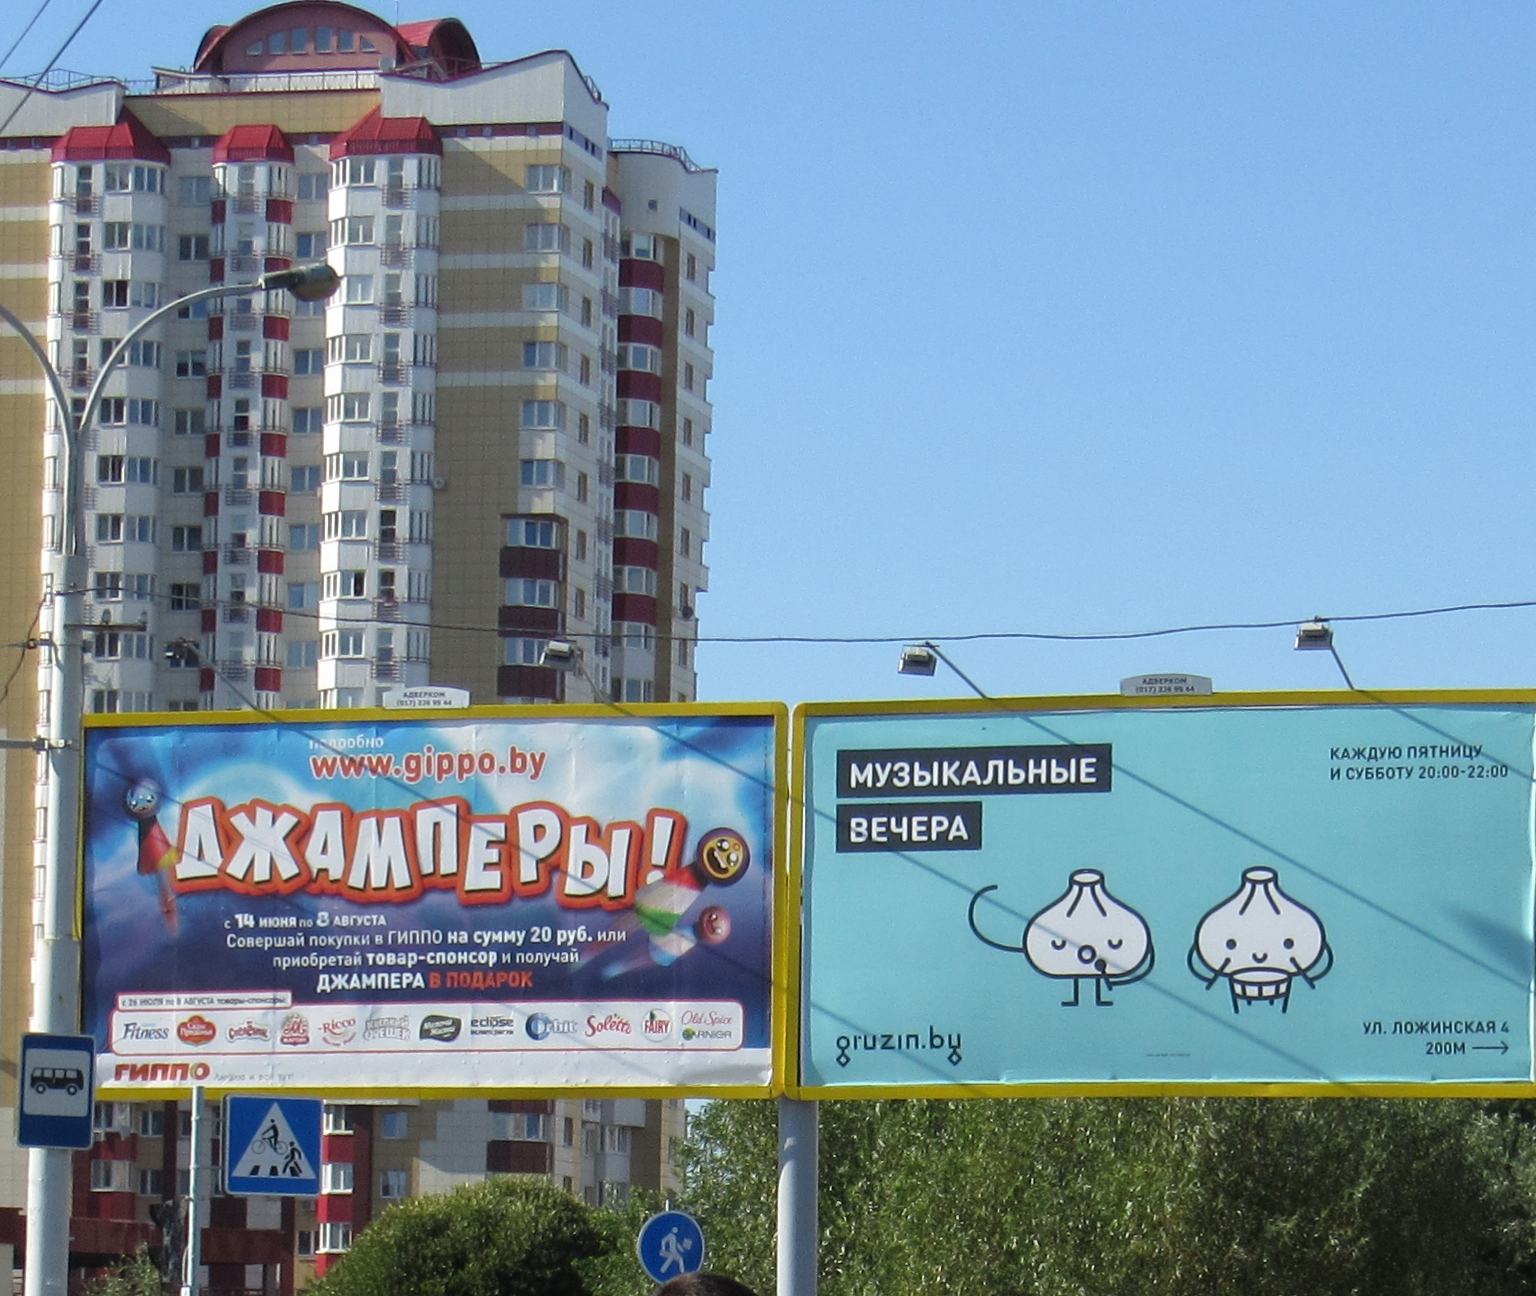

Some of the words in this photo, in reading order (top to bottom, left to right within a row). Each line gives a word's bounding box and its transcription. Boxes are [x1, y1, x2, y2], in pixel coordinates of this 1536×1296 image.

[310, 744, 547, 784] www.gippo.by
[1329, 746, 1403, 763] КАЖДУЮ
[1406, 744, 1483, 761] ПЯТНИЦУ
[849, 757, 1098, 789] МУЗЫКАЛЬНЫЕ
[1329, 768, 1341, 780] И
[1345, 766, 1415, 781] СУББОТУ
[1418, 764, 1509, 780] 20:00-22:00
[849, 814, 969, 844] ВЕЧЕРА
[172, 800, 678, 902] ДЖАМПЕРЫ!
[223, 919, 232, 929] с
[234, 913, 256, 929] 14
[299, 918, 314, 929] по
[316, 911, 331, 928] 8
[332, 914, 387, 928] АВГУСТА
[226, 932, 305, 951] Совершай
[308, 933, 371, 950] покупки
[374, 934, 384, 946] в
[387, 930, 444, 945] ГИППО
[447, 930, 469, 944] на
[473, 929, 527, 947] сумму
[530, 926, 552, 943] 20
[556, 925, 594, 946] руб.
[597, 929, 628, 942] или
[272, 953, 363, 971] приобретай
[365, 950, 498, 969] товар-спонсор
[501, 952, 512, 964] и
[515, 948, 580, 967] получай
[316, 972, 426, 994] ДЖАМПЕРА
[429, 973, 442, 989] В
[446, 971, 535, 990] ПОДАРОК
[123, 1022, 170, 1041] Fitness
[470, 1016, 515, 1030] eclipse
[525, 1012, 578, 1041] Orbit
[644, 1018, 671, 1035] FAIRY
[1362, 1021, 1387, 1035] УЛ.
[1391, 1020, 1497, 1035] ЛОЖИНСКАЯ
[1500, 1020, 1510, 1034] 4
[1424, 1041, 1466, 1056] 200М
[114, 1061, 211, 1082] ГИППО
